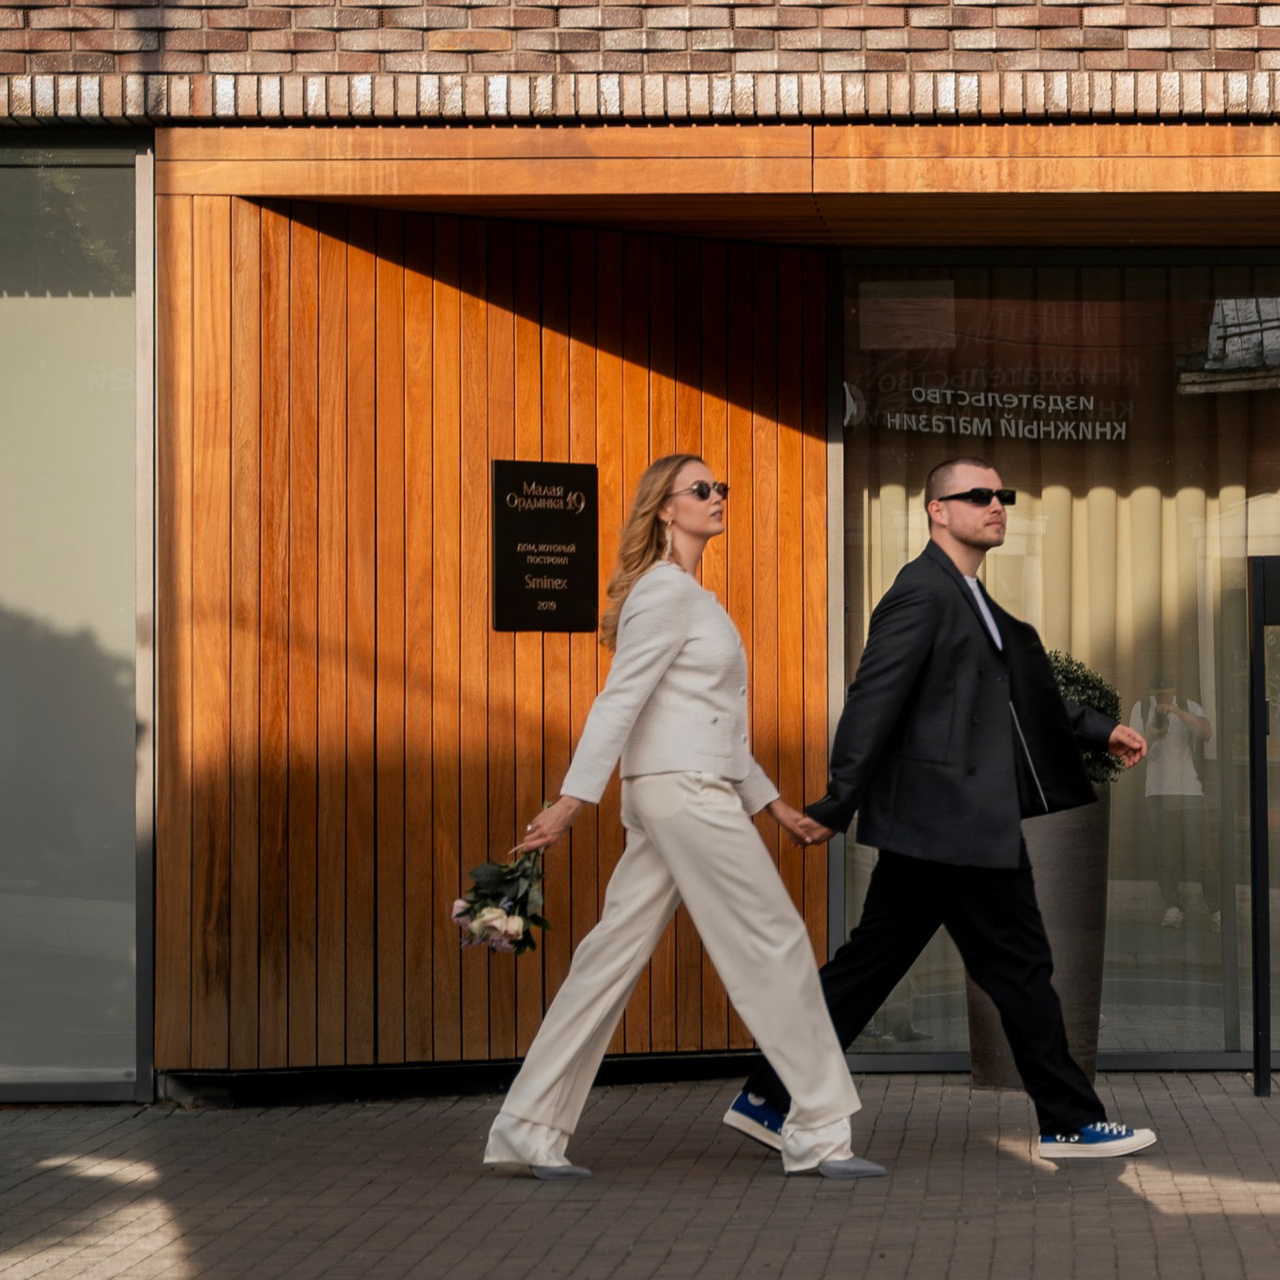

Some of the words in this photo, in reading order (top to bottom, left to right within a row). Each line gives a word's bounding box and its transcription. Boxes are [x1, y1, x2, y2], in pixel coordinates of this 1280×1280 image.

[523, 480, 564, 497] Малая
[506, 492, 565, 512] Ордынка
[566, 491, 586, 515] 19
[524, 574, 568, 590] Sminex
[537, 600, 557, 611] 2019
